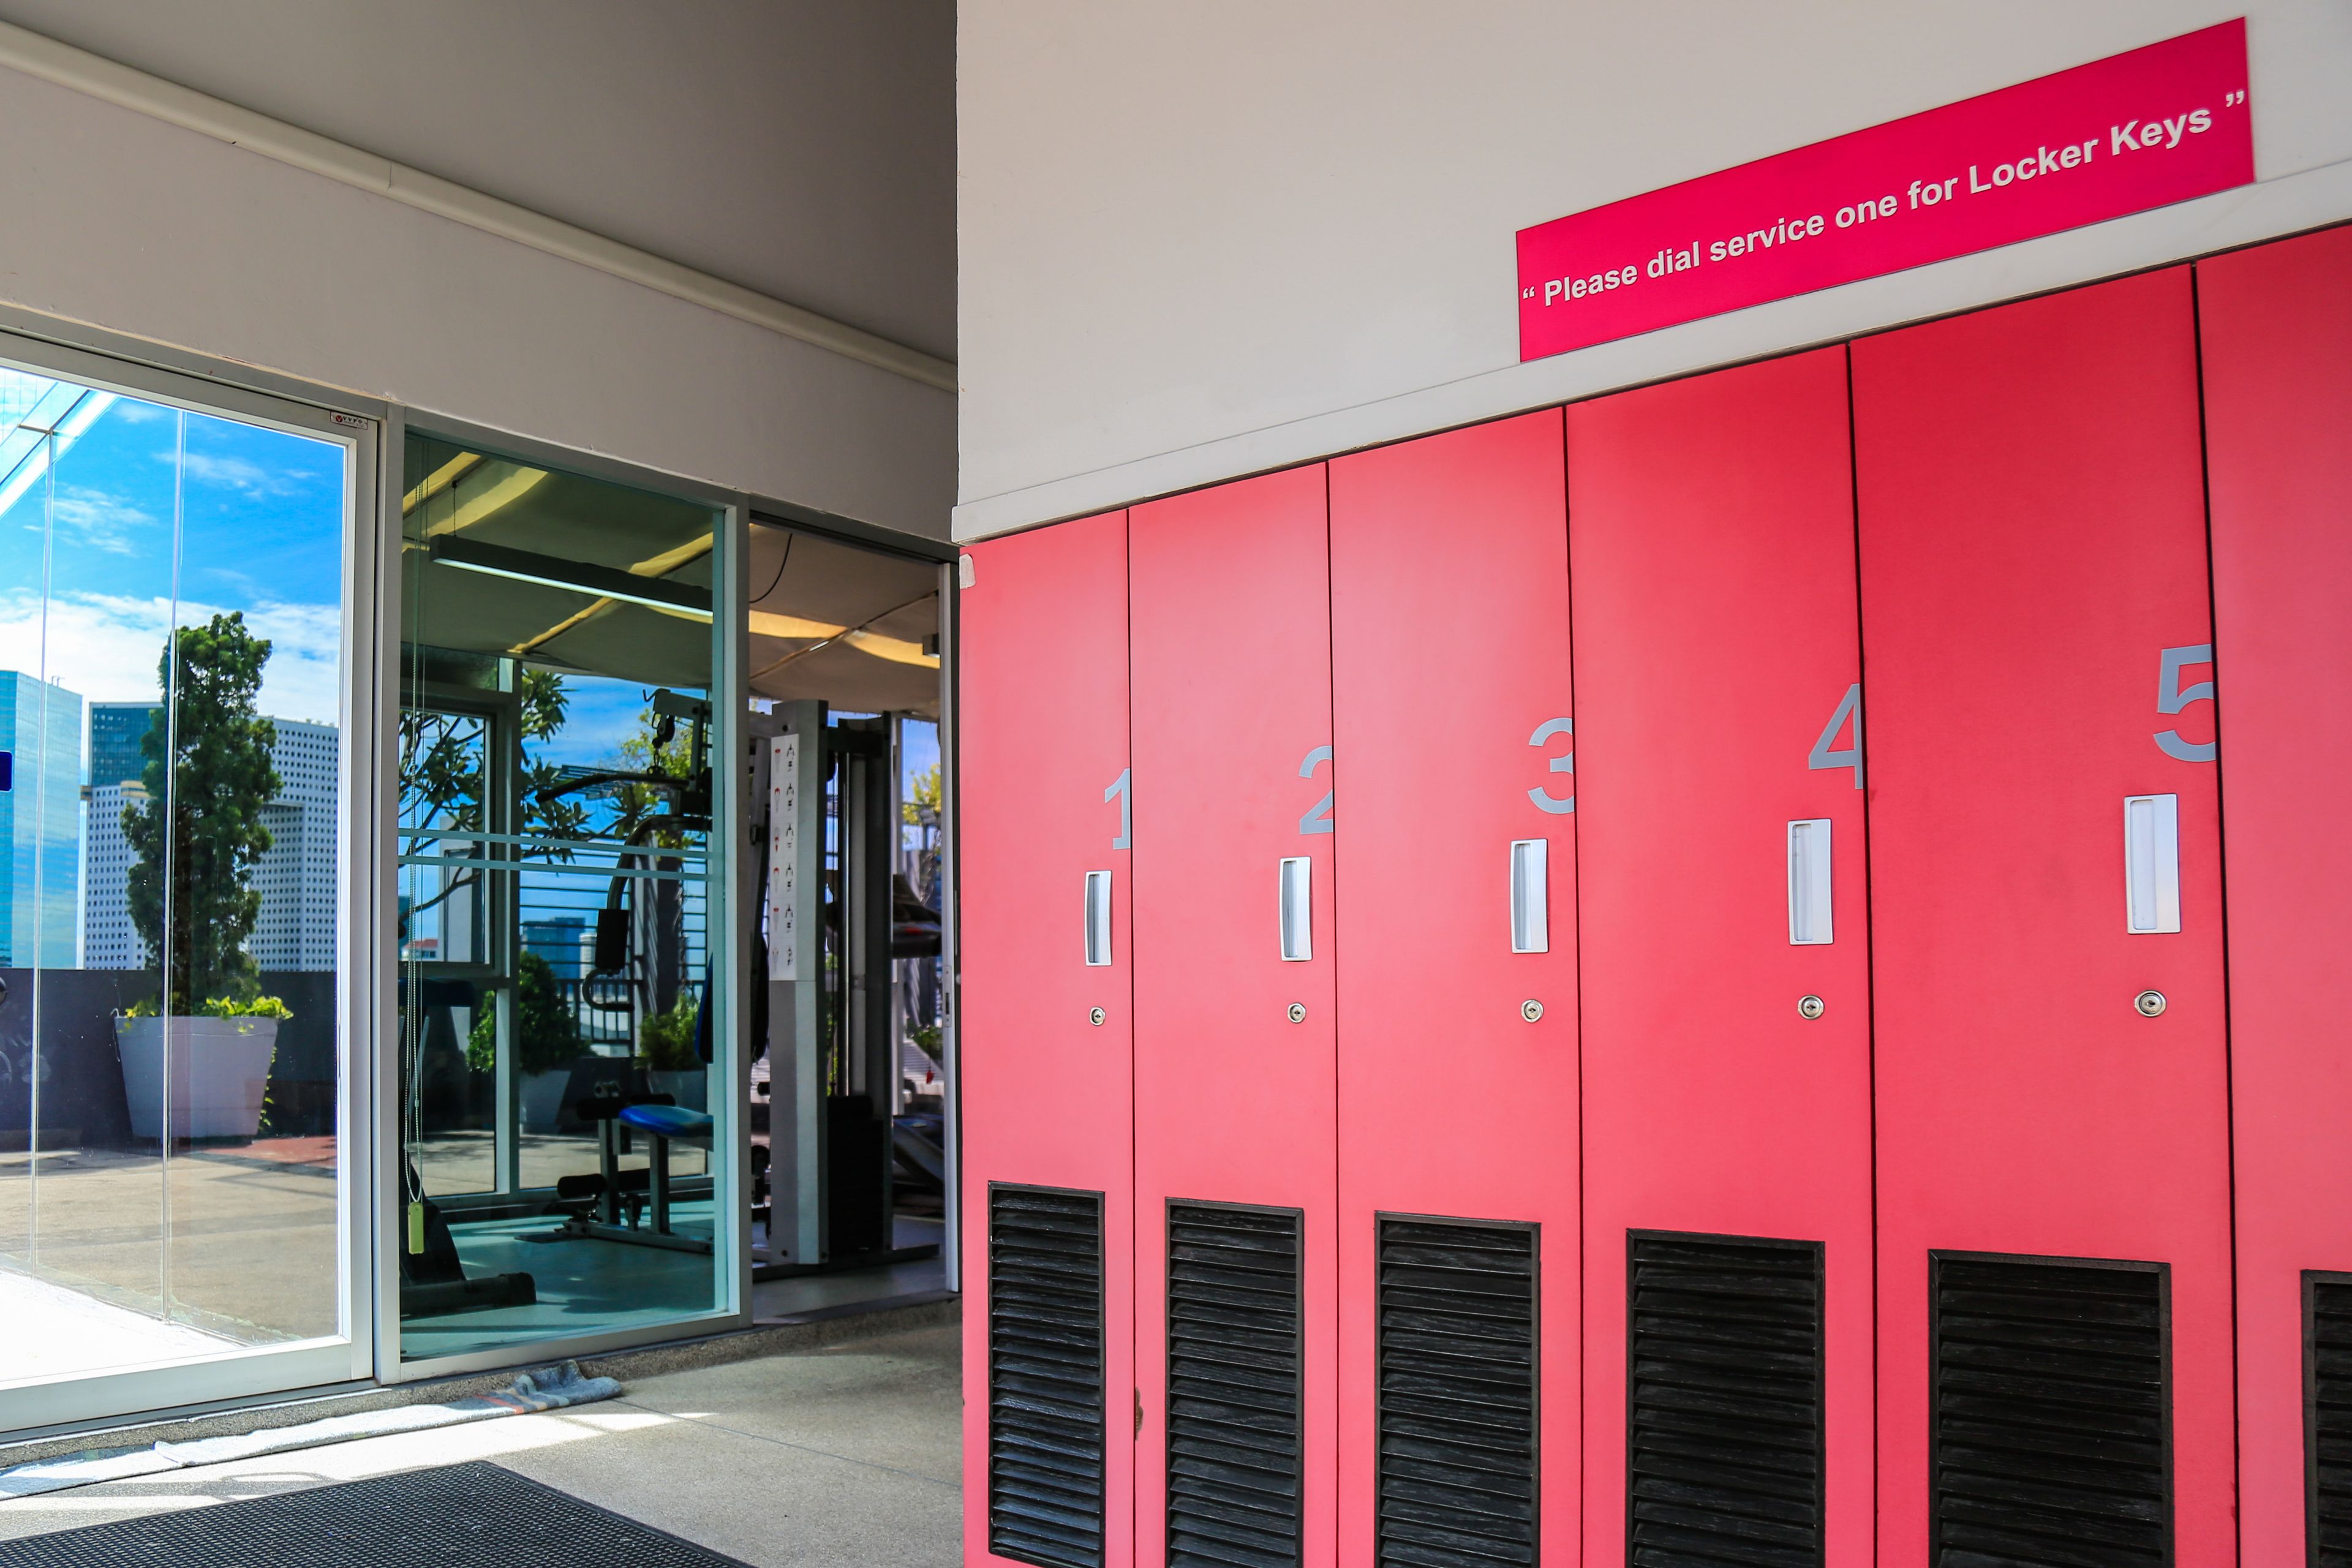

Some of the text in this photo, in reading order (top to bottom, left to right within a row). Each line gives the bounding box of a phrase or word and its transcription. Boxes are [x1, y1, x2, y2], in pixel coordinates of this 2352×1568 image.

[1544, 265, 1638, 307] Please
[1646, 240, 1700, 279] dial
[1709, 216, 1825, 263] service
[1834, 195, 1898, 228] one
[1907, 176, 1959, 210] for
[1969, 138, 2100, 195] Locker
[2110, 108, 2212, 157] Keys
[1808, 683, 1863, 790] 4
[2153, 643, 2216, 763] 5
[1104, 767, 1131, 850] 1
[1298, 745, 1334, 835] 2
[1528, 717, 1575, 815] 3
